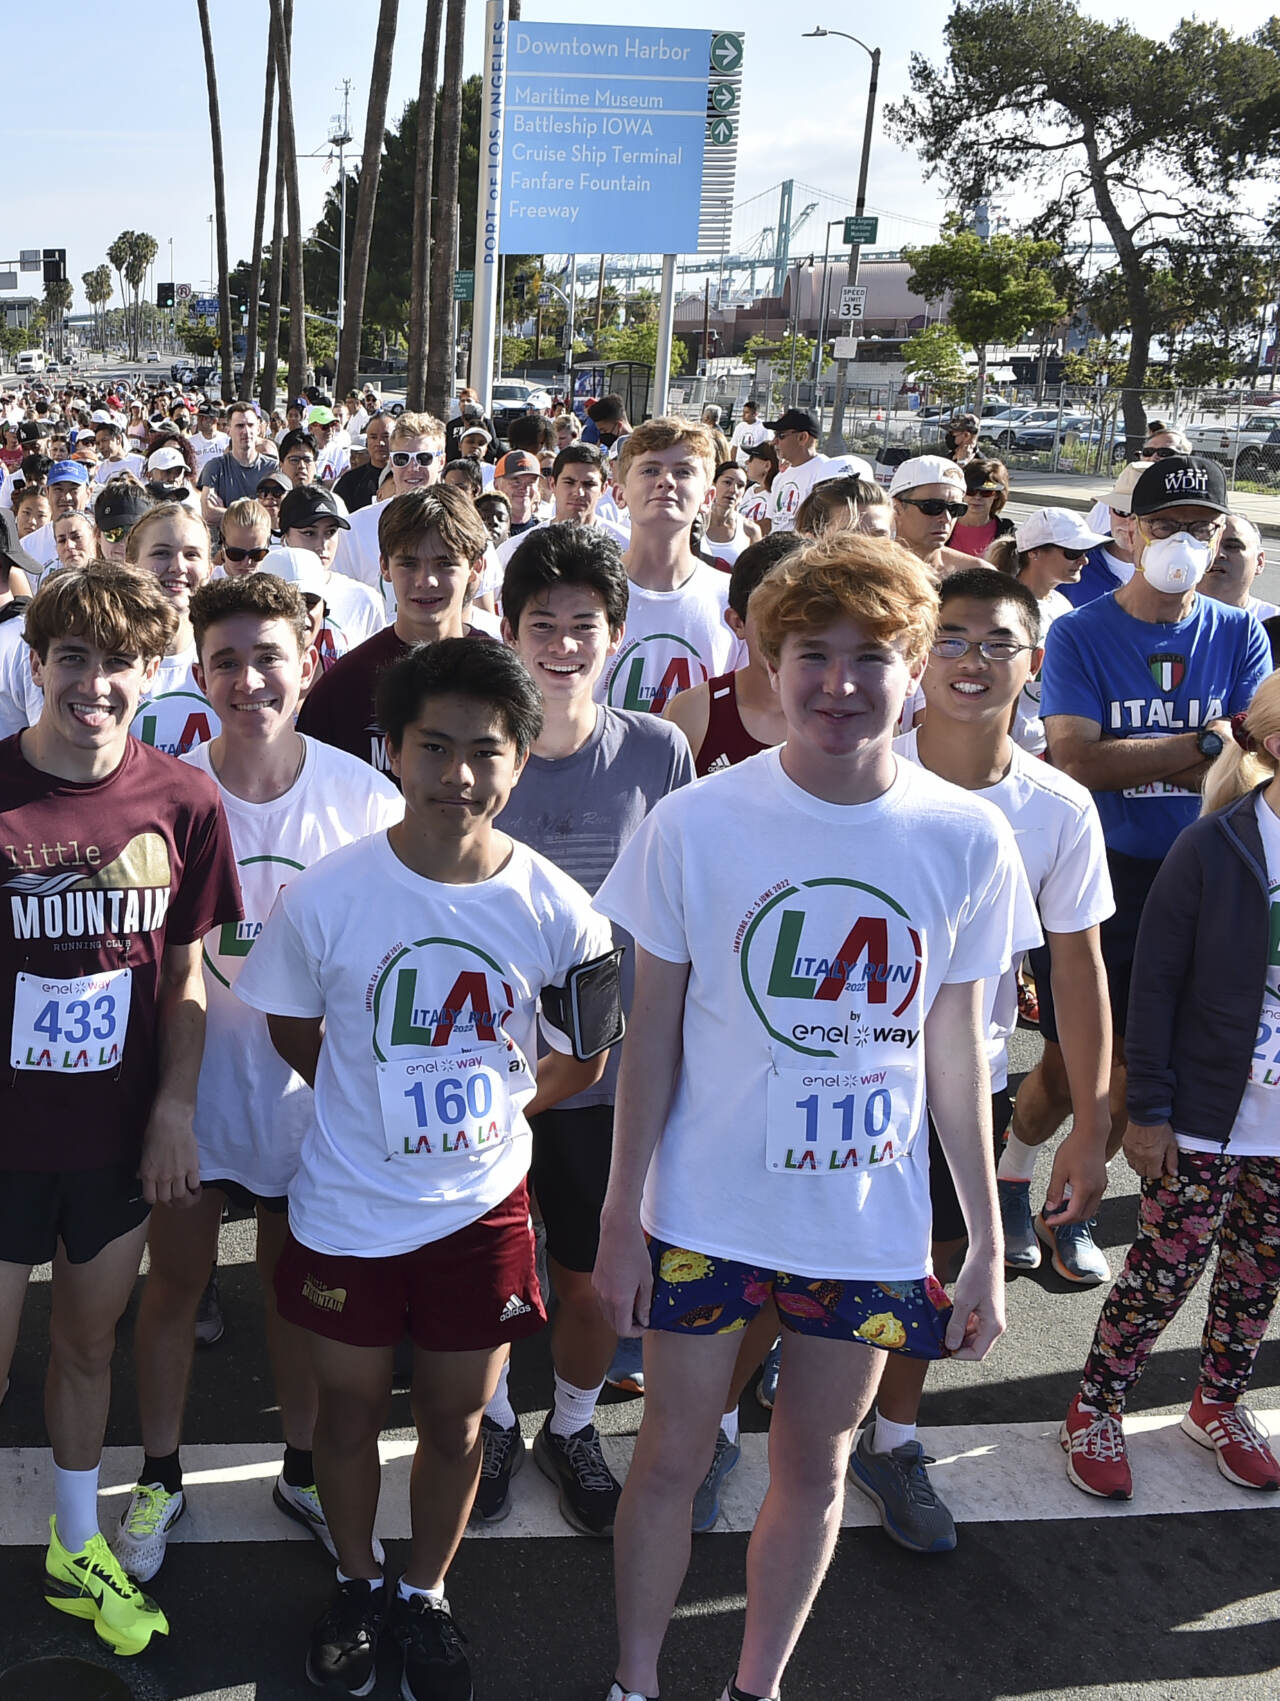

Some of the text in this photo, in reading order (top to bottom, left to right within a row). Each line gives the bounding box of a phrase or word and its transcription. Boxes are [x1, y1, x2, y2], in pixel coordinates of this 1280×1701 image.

[516, 34, 690, 61] Downtown Harbor
[515, 86, 663, 108] Maritime Museum
[513, 114, 653, 138] Battleship IOWA
[483, 20, 506, 264] PORT OF LOS ANGELES
[512, 143, 682, 167] Cruise Ship Terminal
[511, 171, 651, 192] Fanfare Fountain
[509, 201, 579, 222] Freeway
[841, 303, 862, 317] 35
[1110, 698, 1224, 729] ITALIA
[4, 841, 102, 870] little
[10, 887, 171, 940] MOUNTAIN
[238, 922, 264, 939] ITA
[53, 938, 132, 952] RUNNING CLUB
[767, 910, 888, 1004] LA
[794, 957, 913, 984] ITALY RUN
[41, 979, 111, 995] enel way
[844, 982, 867, 992] 2022
[33, 994, 116, 1044] 433
[390, 968, 497, 1047] LA
[413, 1008, 460, 1026] ITALY
[849, 1010, 862, 1023] by
[452, 1024, 475, 1033] 2022
[792, 1024, 921, 1049] enel way
[25, 1043, 118, 1068] LA LA LA
[406, 1056, 484, 1075] enel way
[802, 1071, 887, 1088] enel way
[403, 1072, 492, 1128] 160
[795, 1087, 892, 1142] 110
[403, 1121, 499, 1154] LA LA LA
[784, 1140, 894, 1170] LA LA LA
[301, 1283, 345, 1313] MOUNTAIN
[499, 1303, 532, 1322] adidas
